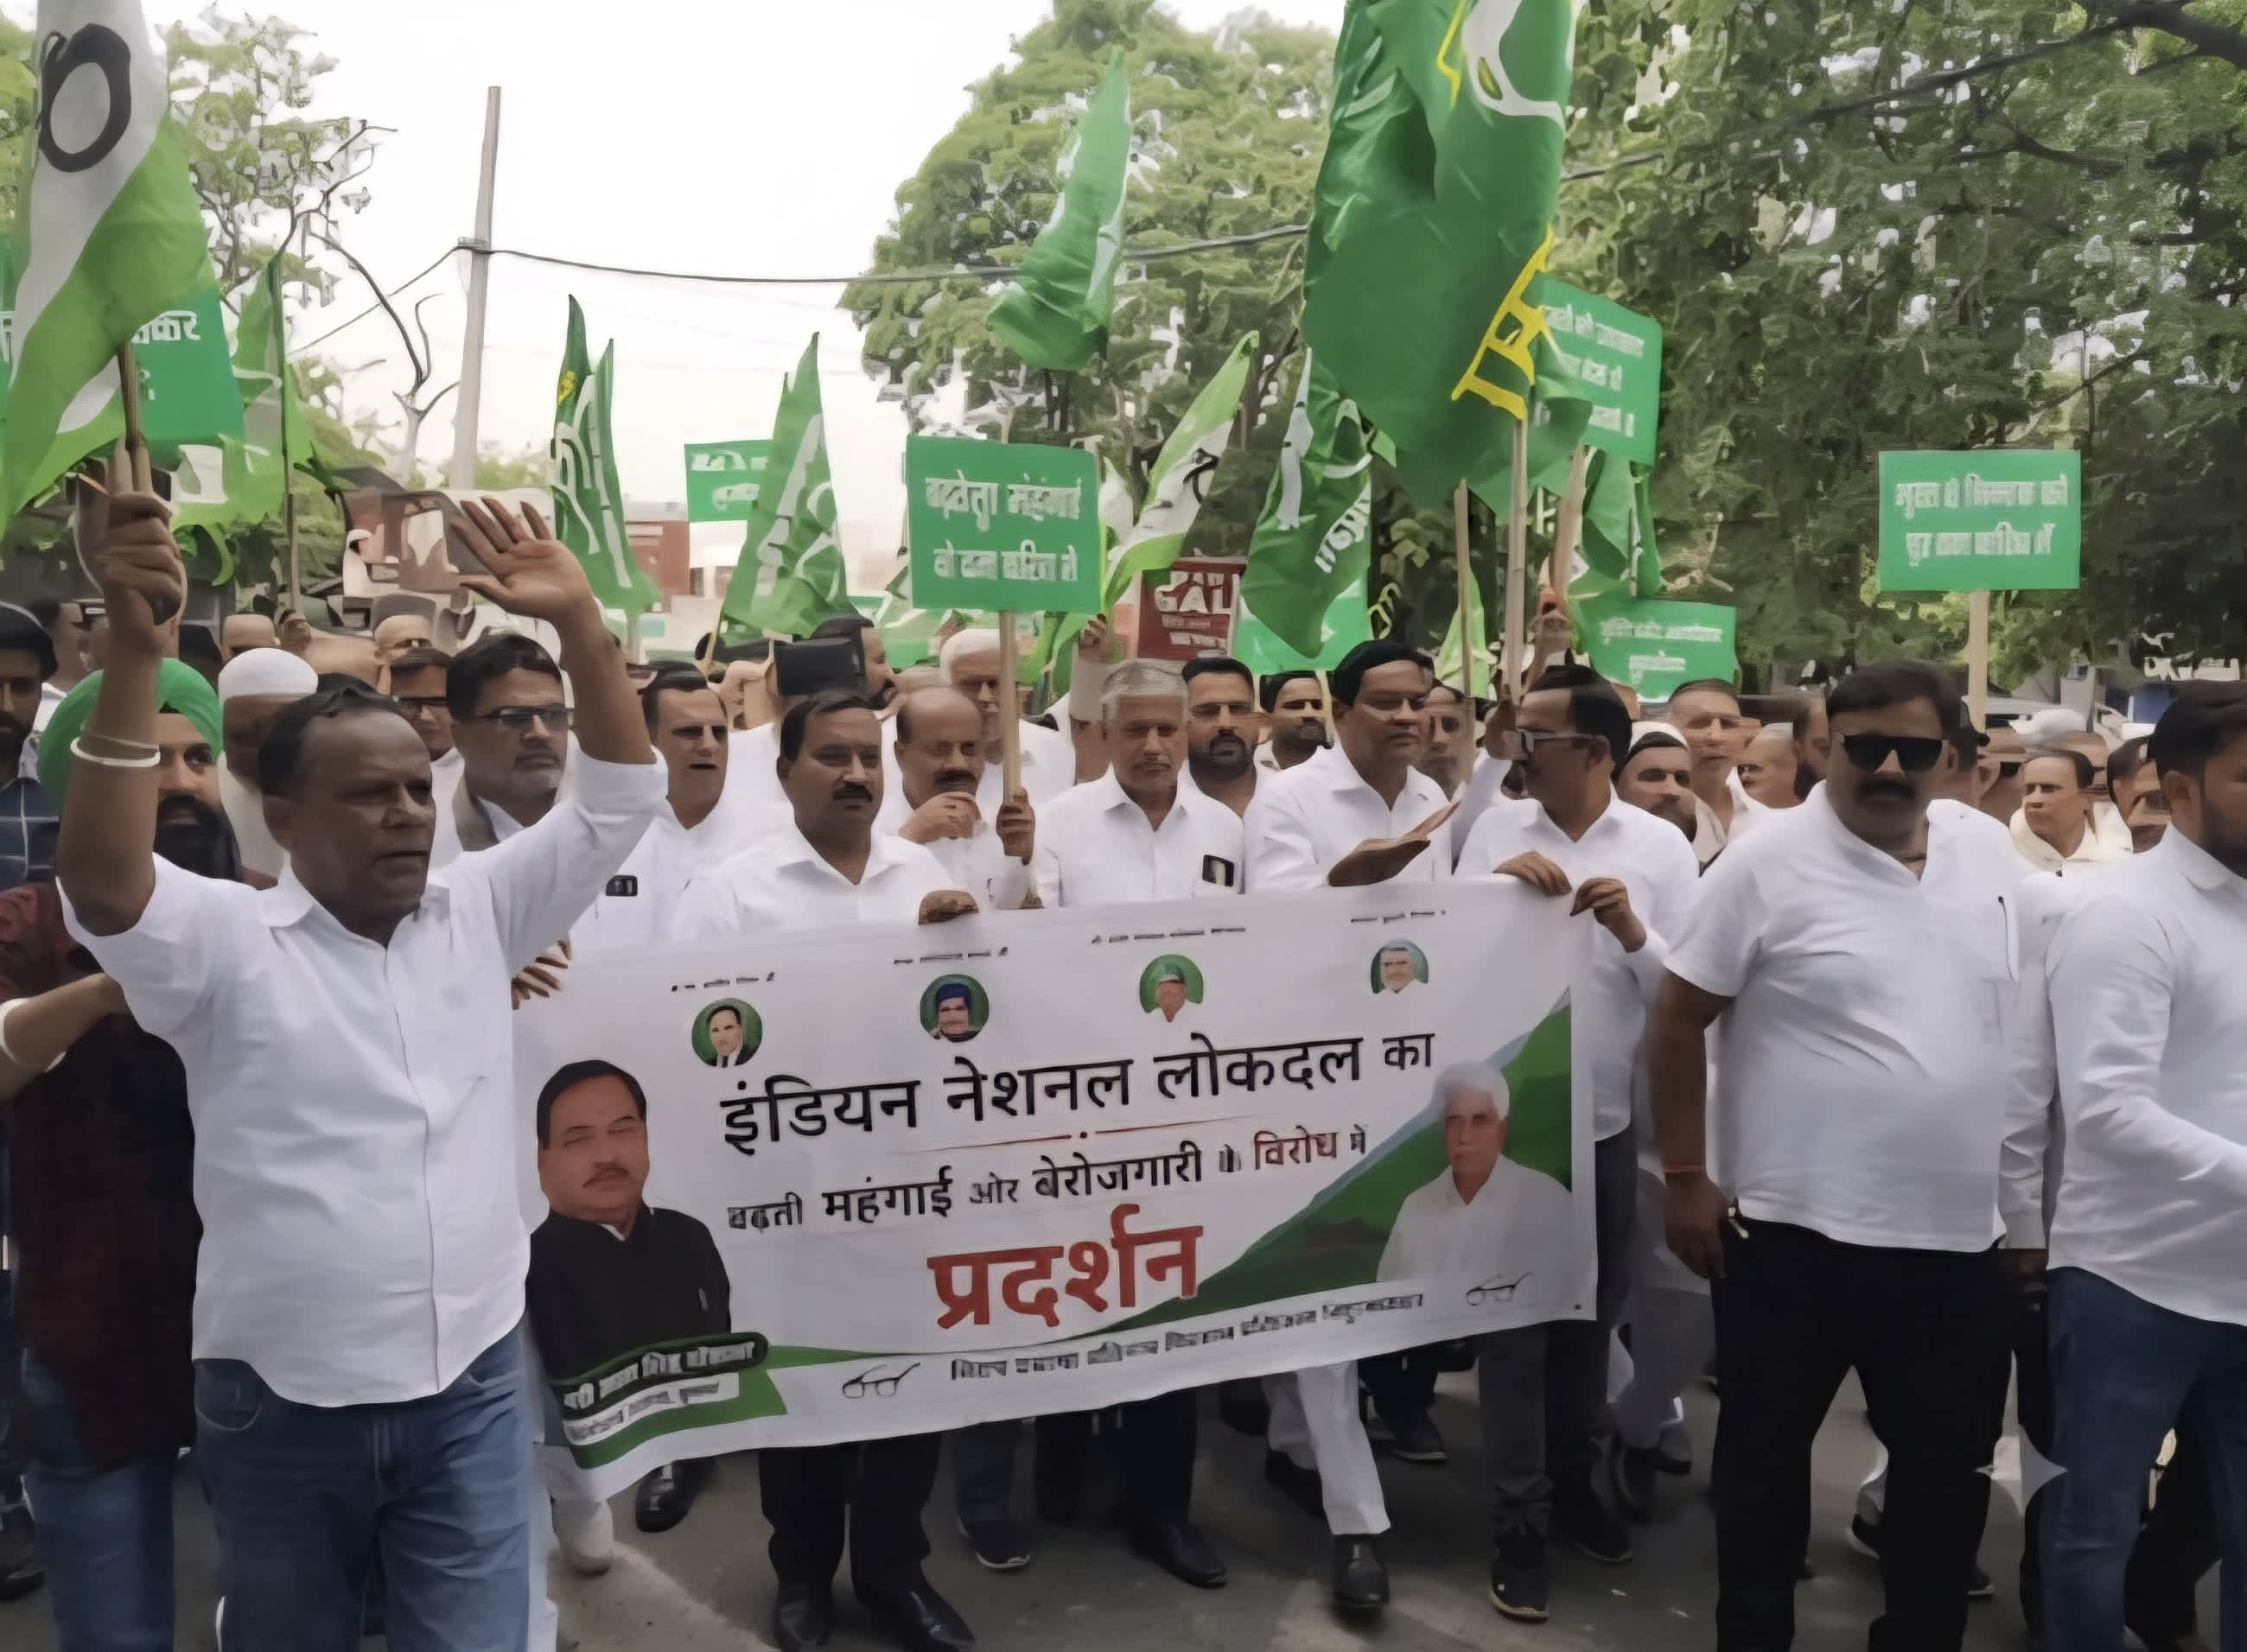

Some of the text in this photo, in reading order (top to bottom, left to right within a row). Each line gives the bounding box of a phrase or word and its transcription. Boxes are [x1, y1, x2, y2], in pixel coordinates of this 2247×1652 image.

[719, 1032, 1435, 1156] इंडियन नेशनल लोकदल का
[821, 1165, 953, 1223] महंगाई
[1032, 1140, 1202, 1198] बेरोजगारी
[926, 1203, 1204, 1330] प्रदर्शन
